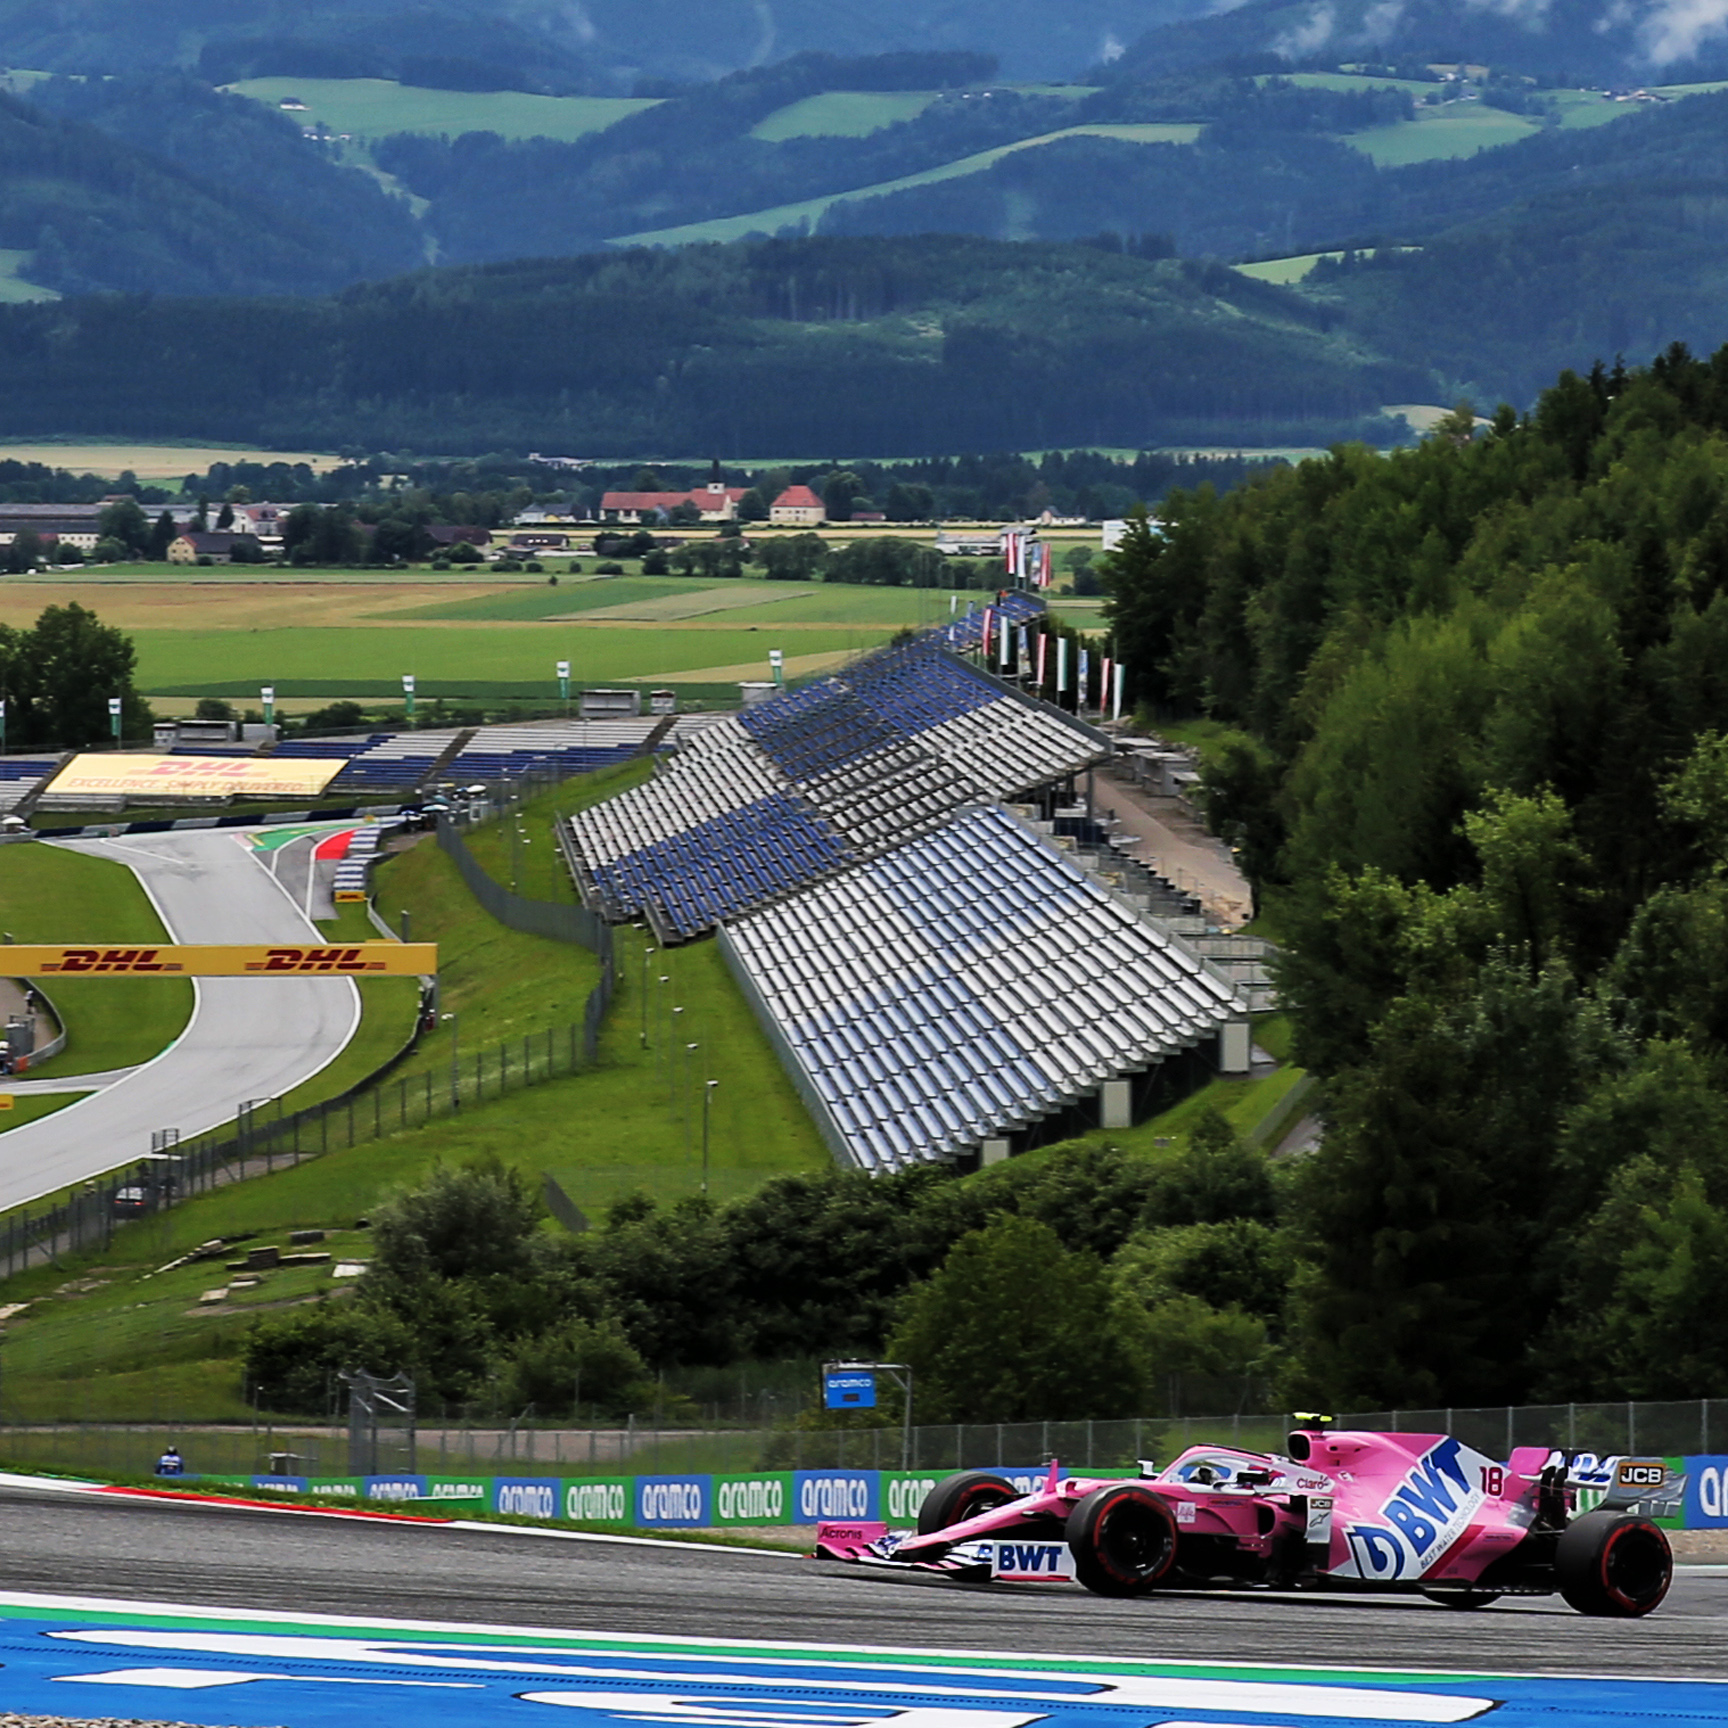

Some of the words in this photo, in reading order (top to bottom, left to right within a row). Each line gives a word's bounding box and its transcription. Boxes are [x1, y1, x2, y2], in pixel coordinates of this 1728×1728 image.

[151, 760, 256, 778] DHL
[59, 949, 166, 972] DHL
[262, 948, 370, 971] DHL
[828, 1377, 872, 1389] aramco
[1296, 1477, 1324, 1491] Claro
[1480, 1466, 1504, 1498] 18
[1621, 1467, 1663, 1484] JCB
[499, 1485, 554, 1519] aramco
[566, 1484, 626, 1520] aramco
[642, 1483, 702, 1520] aramco
[719, 1480, 783, 1519] aramco
[801, 1478, 869, 1517] aramco
[1311, 1499, 1332, 1509] JCB
[1383, 1437, 1462, 1559] BWT
[821, 1526, 863, 1540] Acronis
[999, 1544, 1063, 1572] BWT
